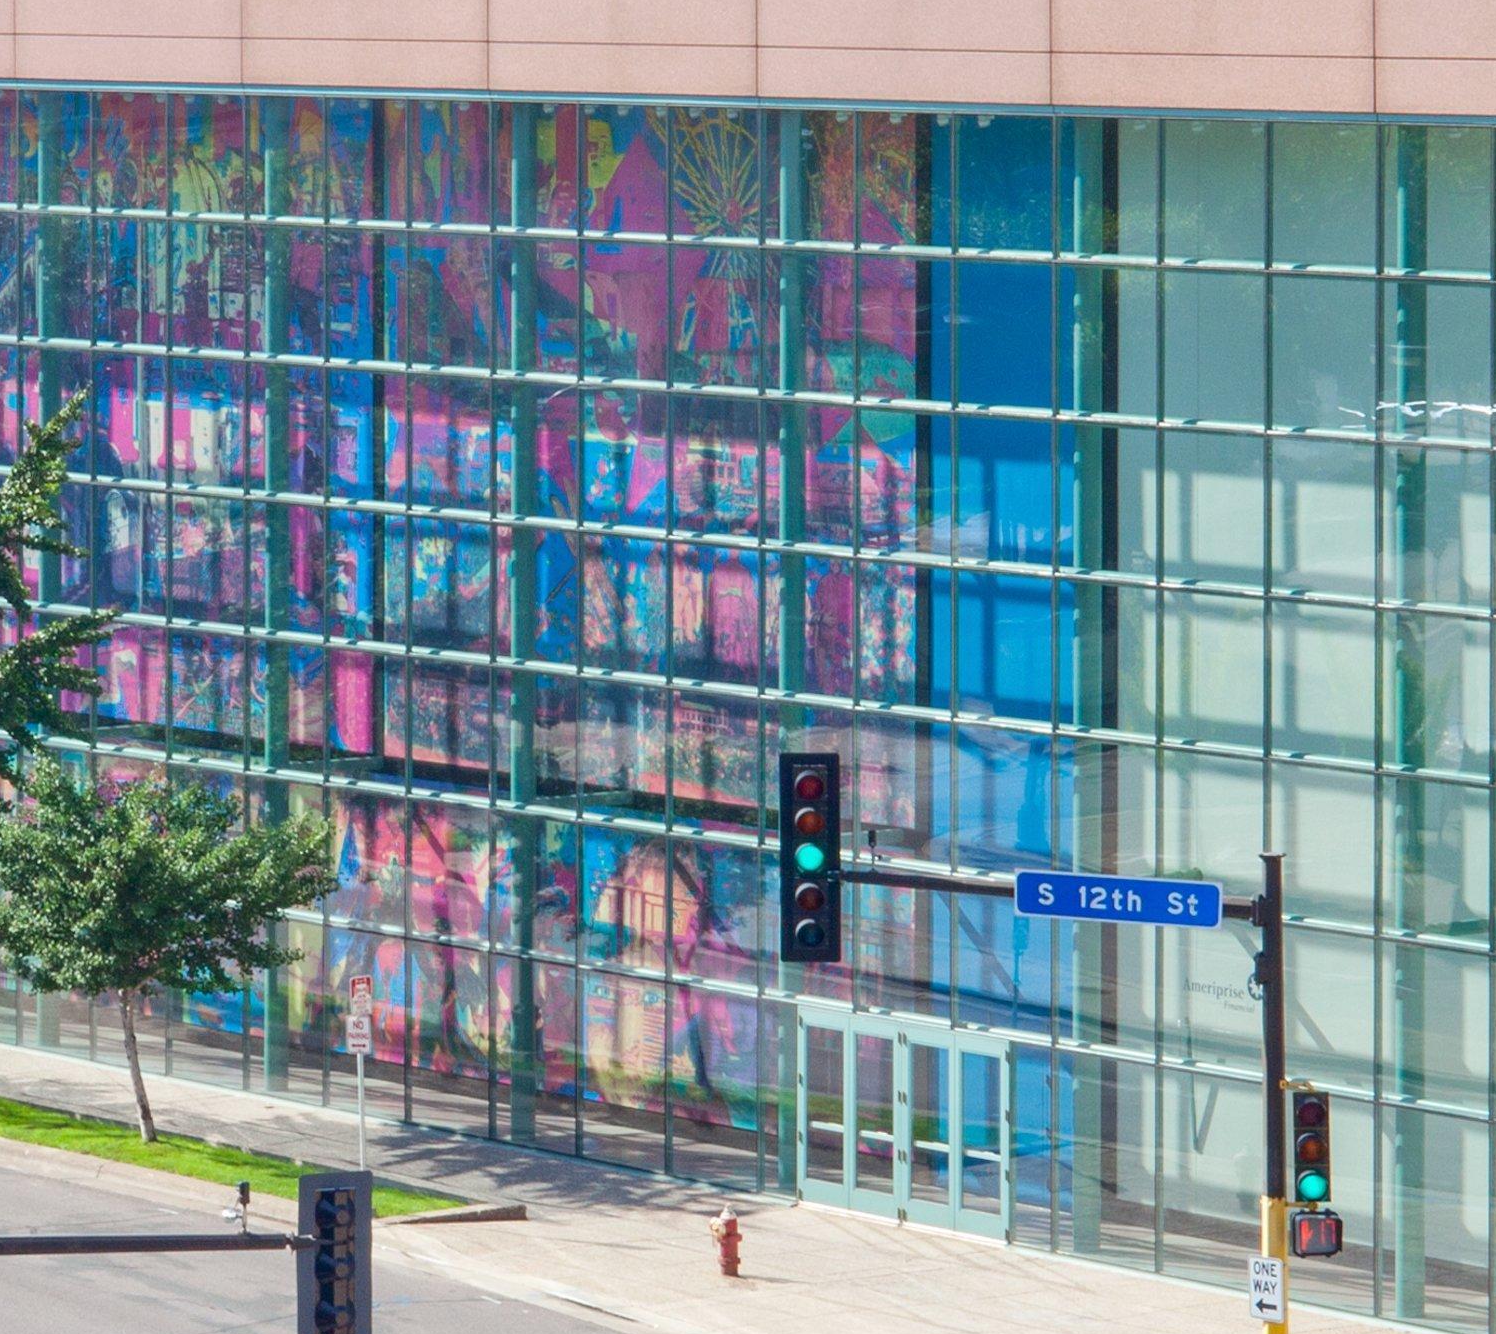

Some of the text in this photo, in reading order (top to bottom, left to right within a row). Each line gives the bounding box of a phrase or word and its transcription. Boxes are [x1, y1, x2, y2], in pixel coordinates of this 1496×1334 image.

[1038, 882, 1199, 916] S 12th St
[1183, 976, 1245, 999] Ameriprise
[353, 1020, 364, 1030] NO
[1253, 1260, 1278, 1278] ONE
[1252, 1278, 1278, 1295] WAY
